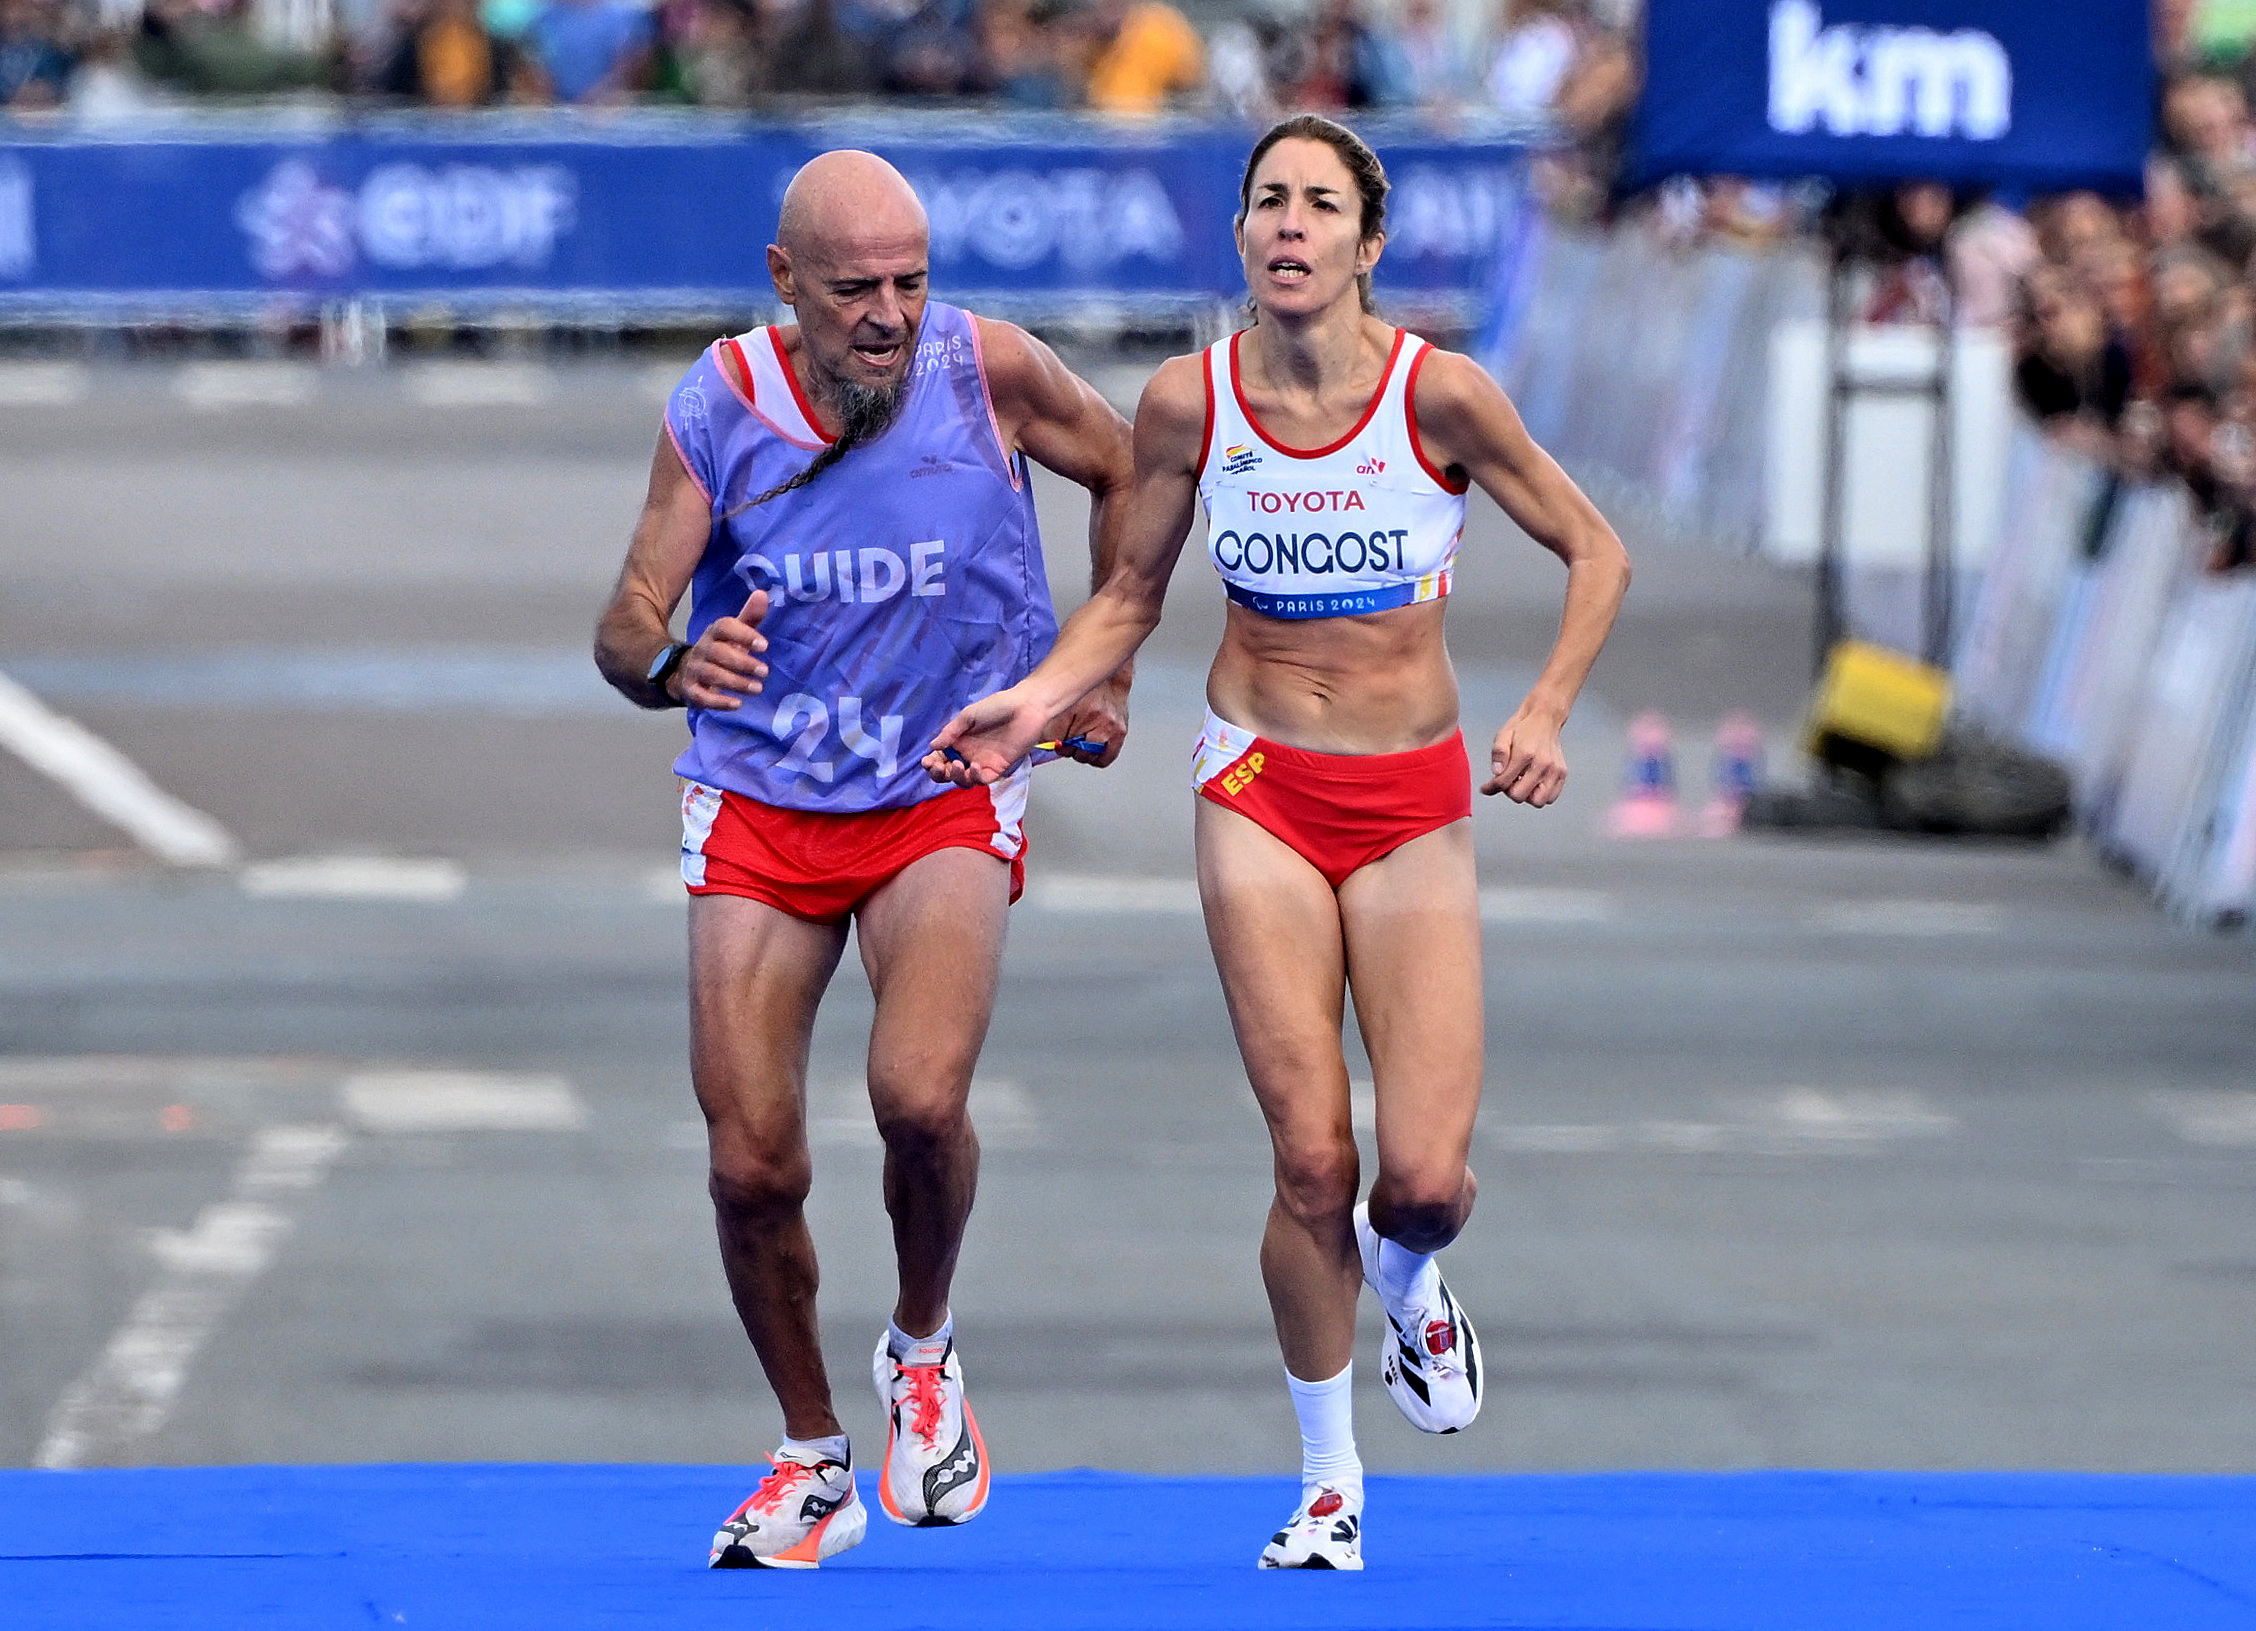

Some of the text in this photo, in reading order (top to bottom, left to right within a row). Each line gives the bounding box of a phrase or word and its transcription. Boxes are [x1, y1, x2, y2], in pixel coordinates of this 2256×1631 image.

[1767, 0, 2012, 140] km
[915, 353, 964, 377] 2024
[1247, 490, 1366, 513] TOYOTA
[734, 540, 946, 607] GUIDE
[1215, 529, 1409, 574] CONGOST
[1276, 597, 1376, 613] PARIS 2024
[771, 692, 904, 783] 24
[1221, 752, 1265, 796] ESP
